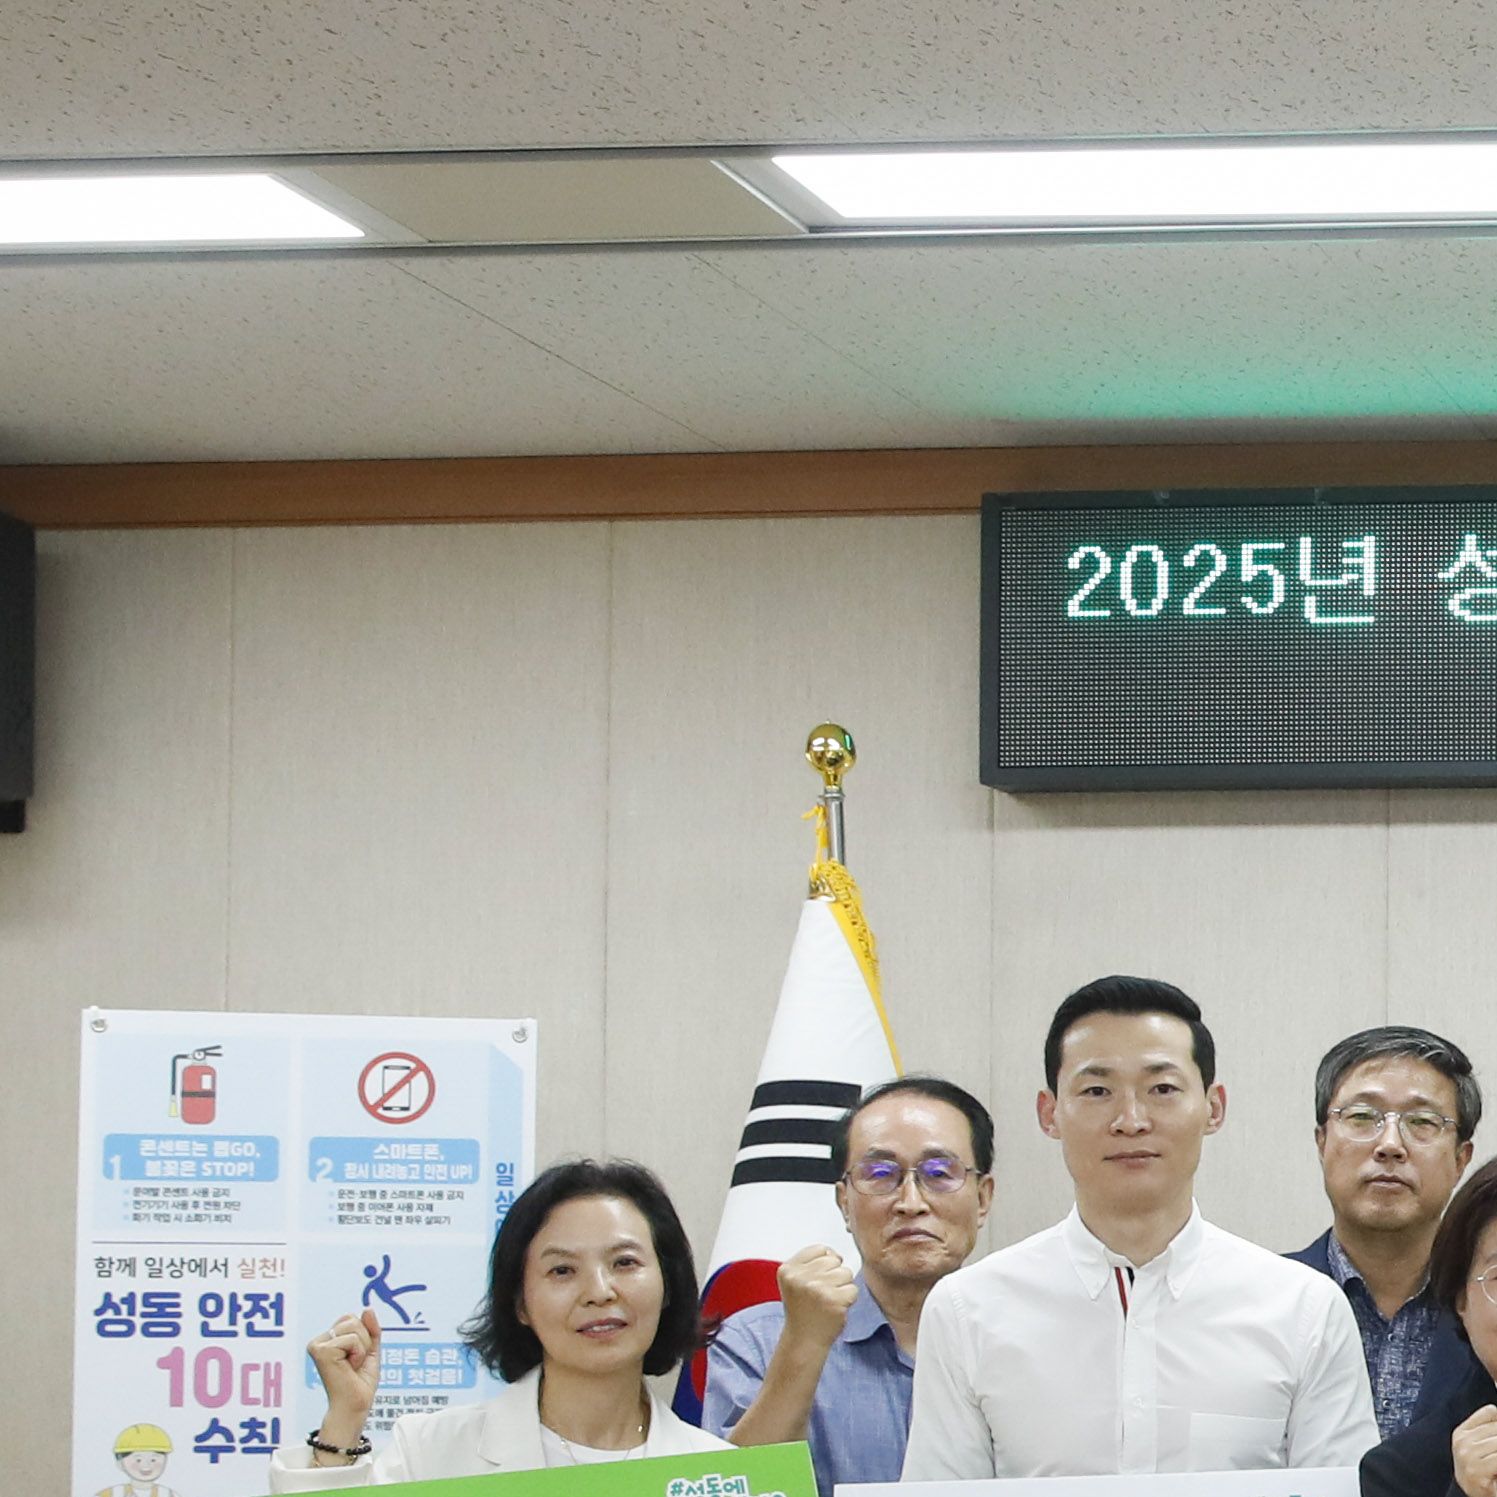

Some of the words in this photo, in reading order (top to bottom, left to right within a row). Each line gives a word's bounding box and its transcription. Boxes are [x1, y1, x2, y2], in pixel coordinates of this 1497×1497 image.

[1064, 534, 1376, 626] 2025년
[139, 1139, 208, 1157] 콘센트는
[373, 1143, 445, 1160] 스마트폰,
[109, 1154, 121, 1180] 1
[145, 1160, 197, 1177] 불꽃은
[201, 1162, 255, 1177] STOP!
[315, 1157, 334, 1183] 2
[372, 1163, 420, 1180] 내려놓고
[424, 1164, 449, 1180] 안전
[451, 1164, 473, 1180] UP!
[390, 1190, 425, 1200] 스마트폰
[94, 1256, 137, 1279] 함께
[144, 1257, 229, 1279] 일상에서
[237, 1257, 286, 1280] 실천!
[93, 1291, 183, 1338] 성동
[198, 1292, 285, 1338] 안전
[381, 1349, 419, 1366] 정돈
[425, 1348, 463, 1367] 습관,
[156, 1346, 283, 1408] 10대
[408, 1368, 463, 1385] 첫걸음!
[193, 1417, 280, 1464] 수칙
